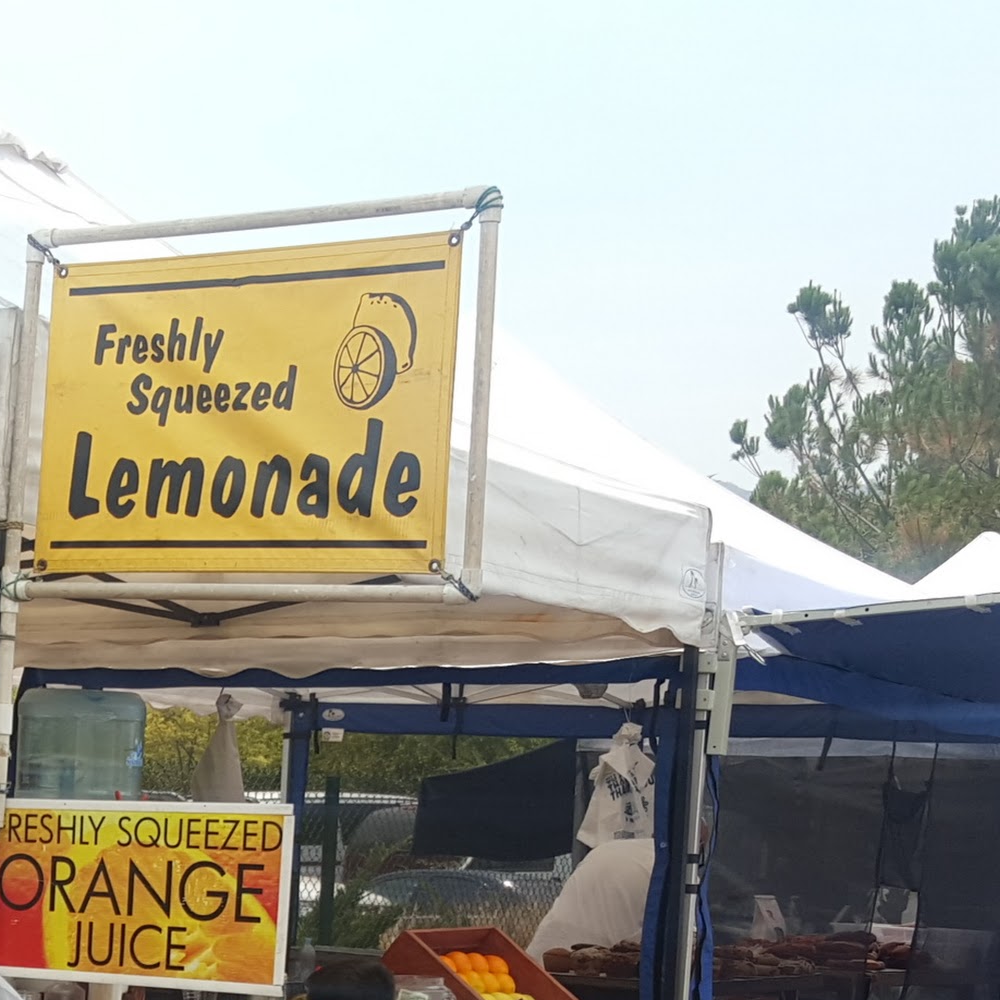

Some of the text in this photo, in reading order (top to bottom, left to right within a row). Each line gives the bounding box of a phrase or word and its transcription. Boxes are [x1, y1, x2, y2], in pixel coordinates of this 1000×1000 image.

[94, 316, 224, 374] Freshly
[126, 364, 298, 427] Squeezed
[68, 417, 421, 519] Lemonade
[7, 813, 283, 851] RESHLY SQUEEZED
[67, 921, 187, 971] JUICE
